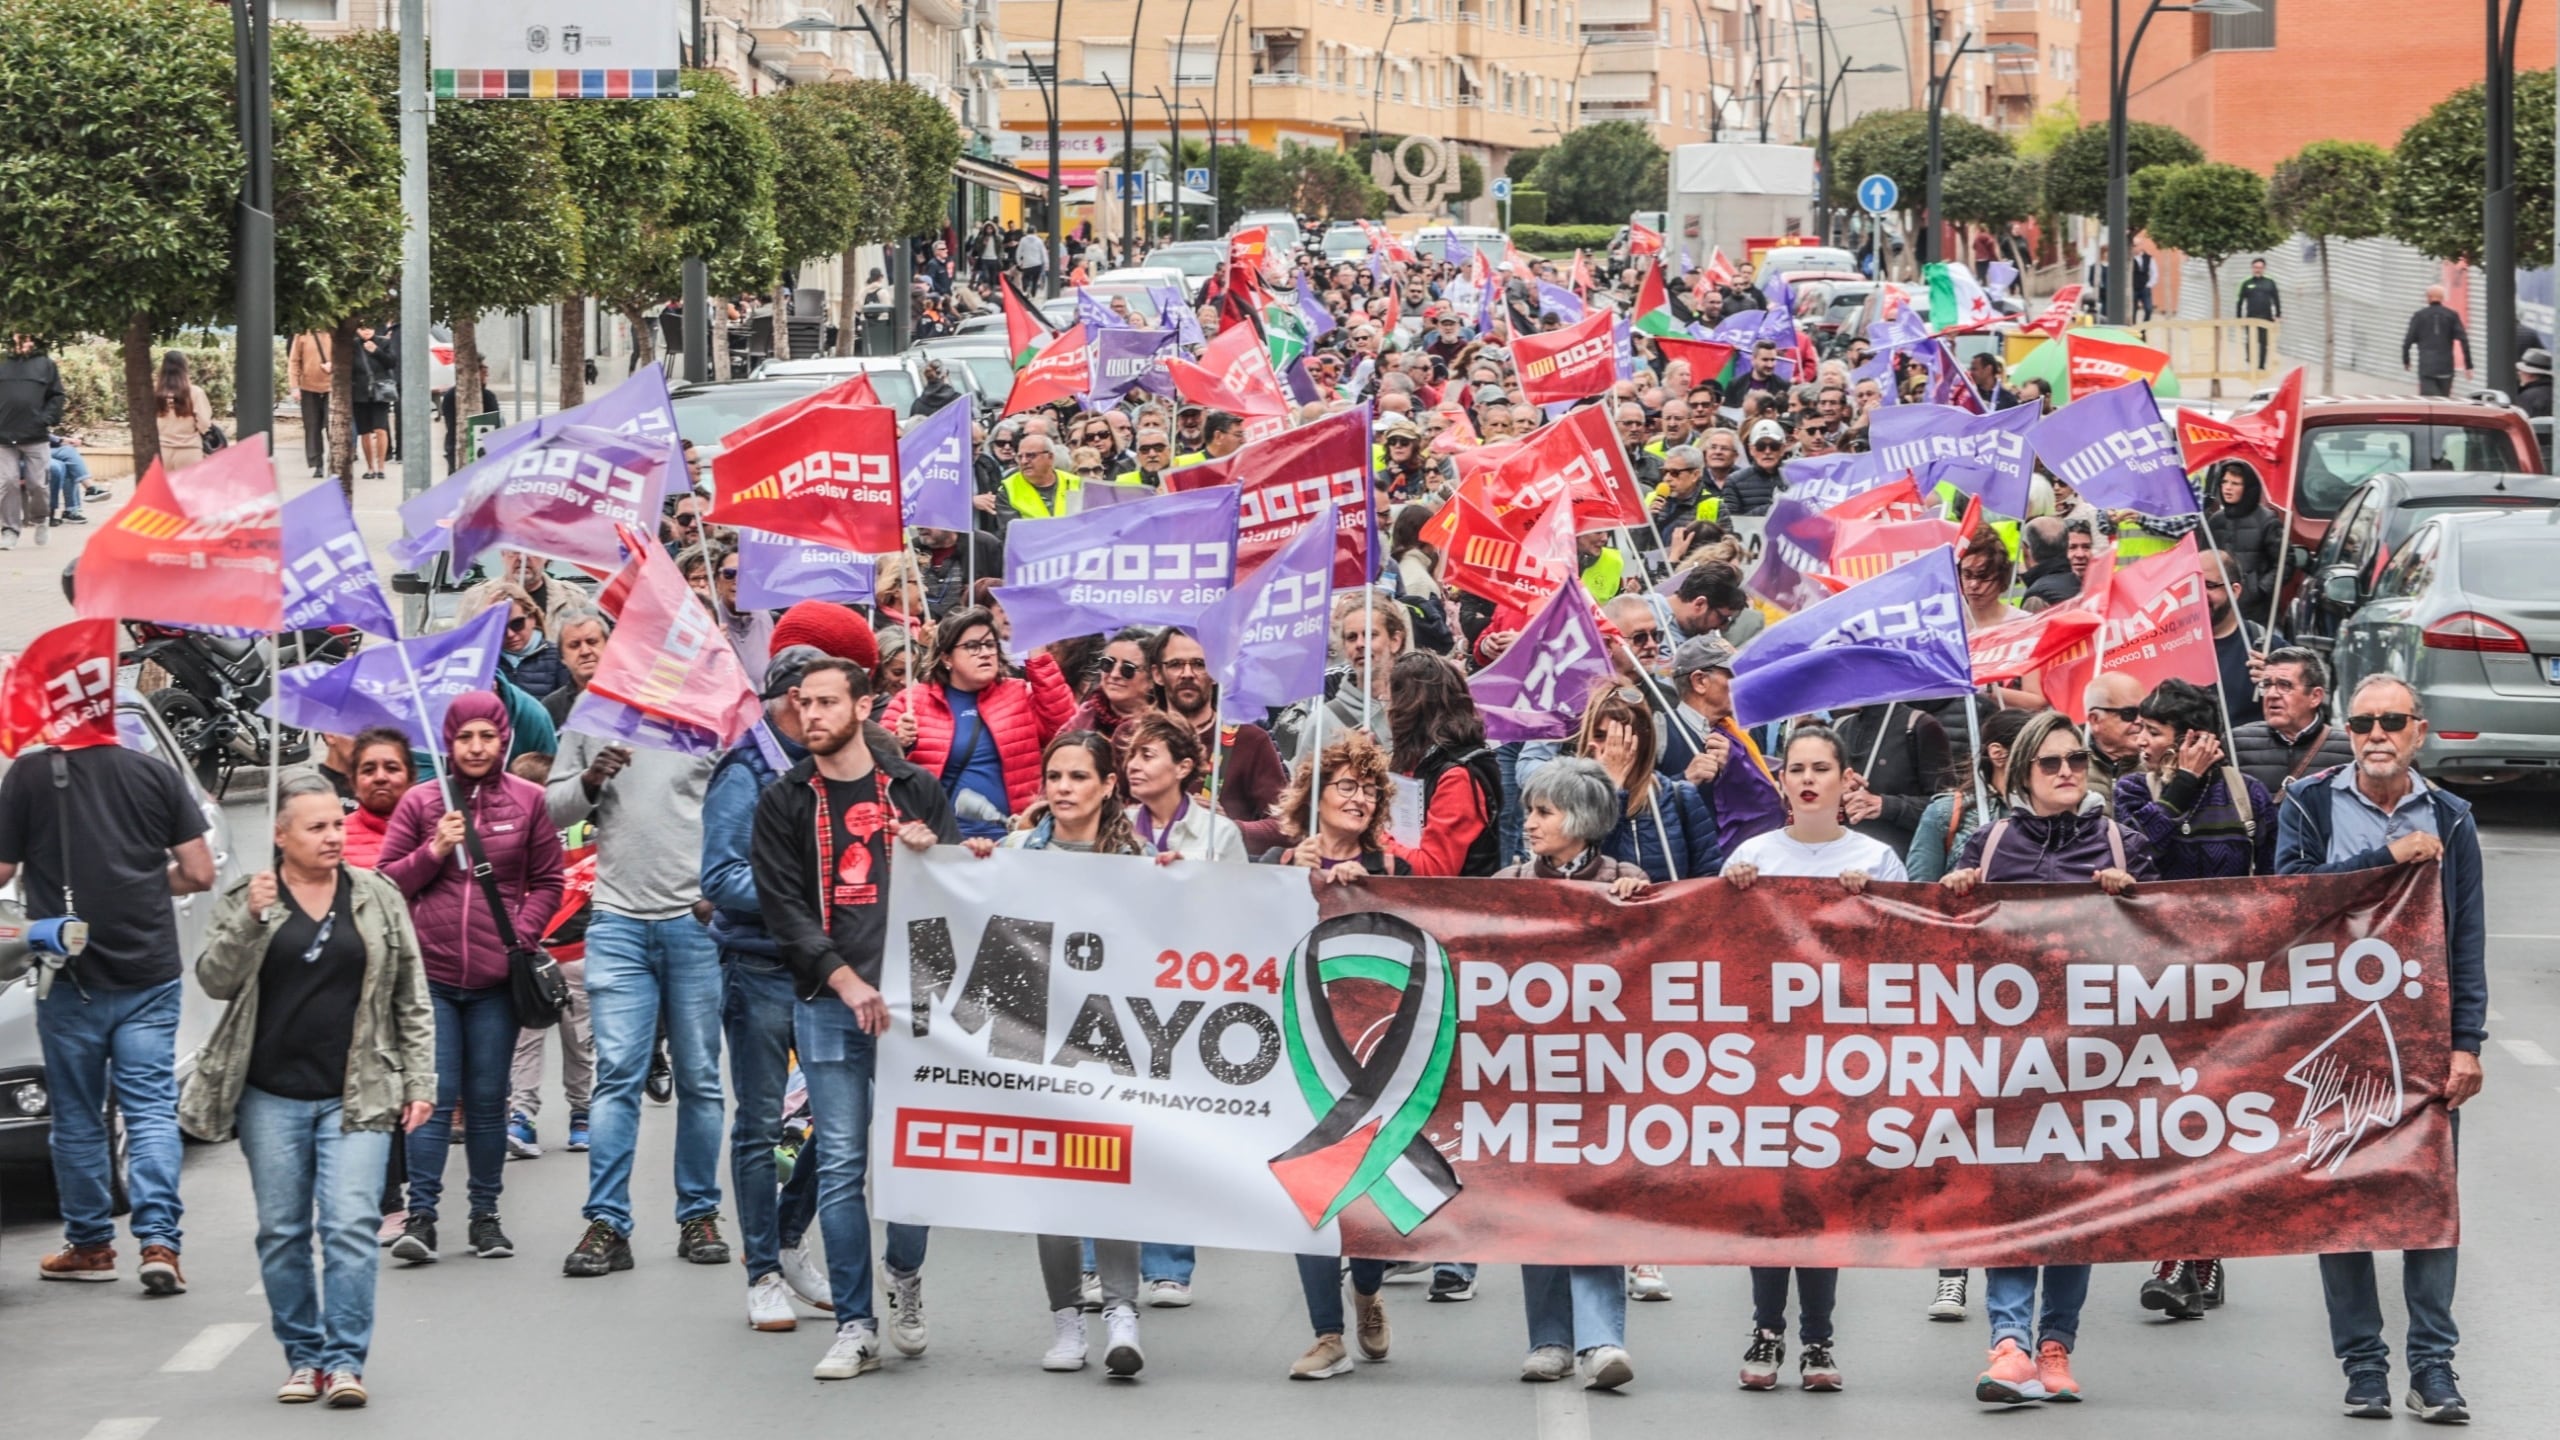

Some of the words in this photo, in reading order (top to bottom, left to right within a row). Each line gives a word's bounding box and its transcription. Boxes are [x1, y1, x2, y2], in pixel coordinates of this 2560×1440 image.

[1154, 948, 1281, 994] 2024
[1459, 961, 1627, 1025] POR
[1651, 960, 1749, 1023] EL
[1771, 961, 2040, 1027] PLENO
[2066, 937, 2423, 1027] EMPLEO:
[914, 1066, 1095, 1097] #PLENOEMPLEO
[1119, 1087, 1272, 1119] #1MAYO2024
[1460, 1032, 1757, 1097] MENOS
[1778, 1033, 2198, 1098] JORNADA,
[904, 1120, 1058, 1167] CCOO
[1461, 1101, 1842, 1170] MEJORES
[1865, 1090, 2281, 1170] SALARIOS
